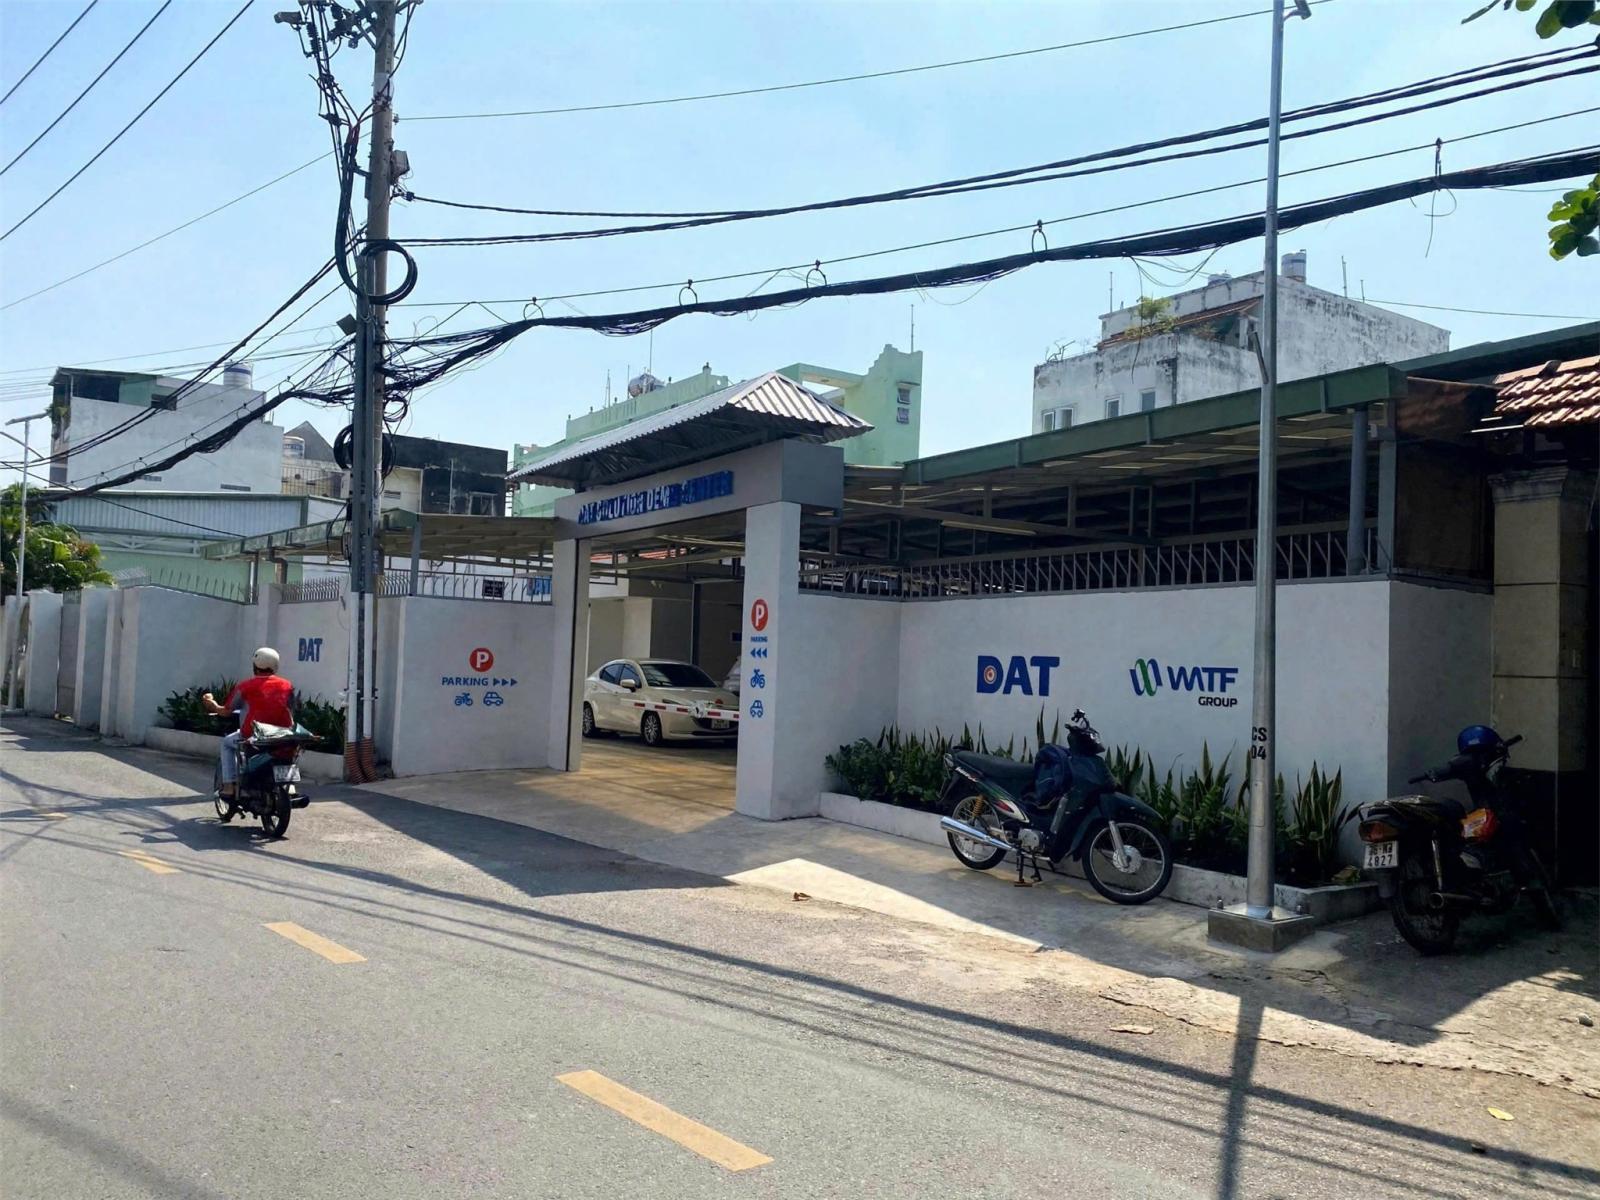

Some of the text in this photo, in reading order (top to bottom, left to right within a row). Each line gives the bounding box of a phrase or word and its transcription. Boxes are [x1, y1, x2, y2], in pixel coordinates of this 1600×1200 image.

[298, 637, 323, 662] DAT
[476, 651, 489, 668] P
[441, 676, 489, 686] PARKING
[976, 655, 1060, 697] DAT
[1167, 666, 1239, 692] WATF
[1198, 696, 1238, 707] GROUP
[1367, 854, 1393, 867] 4827
